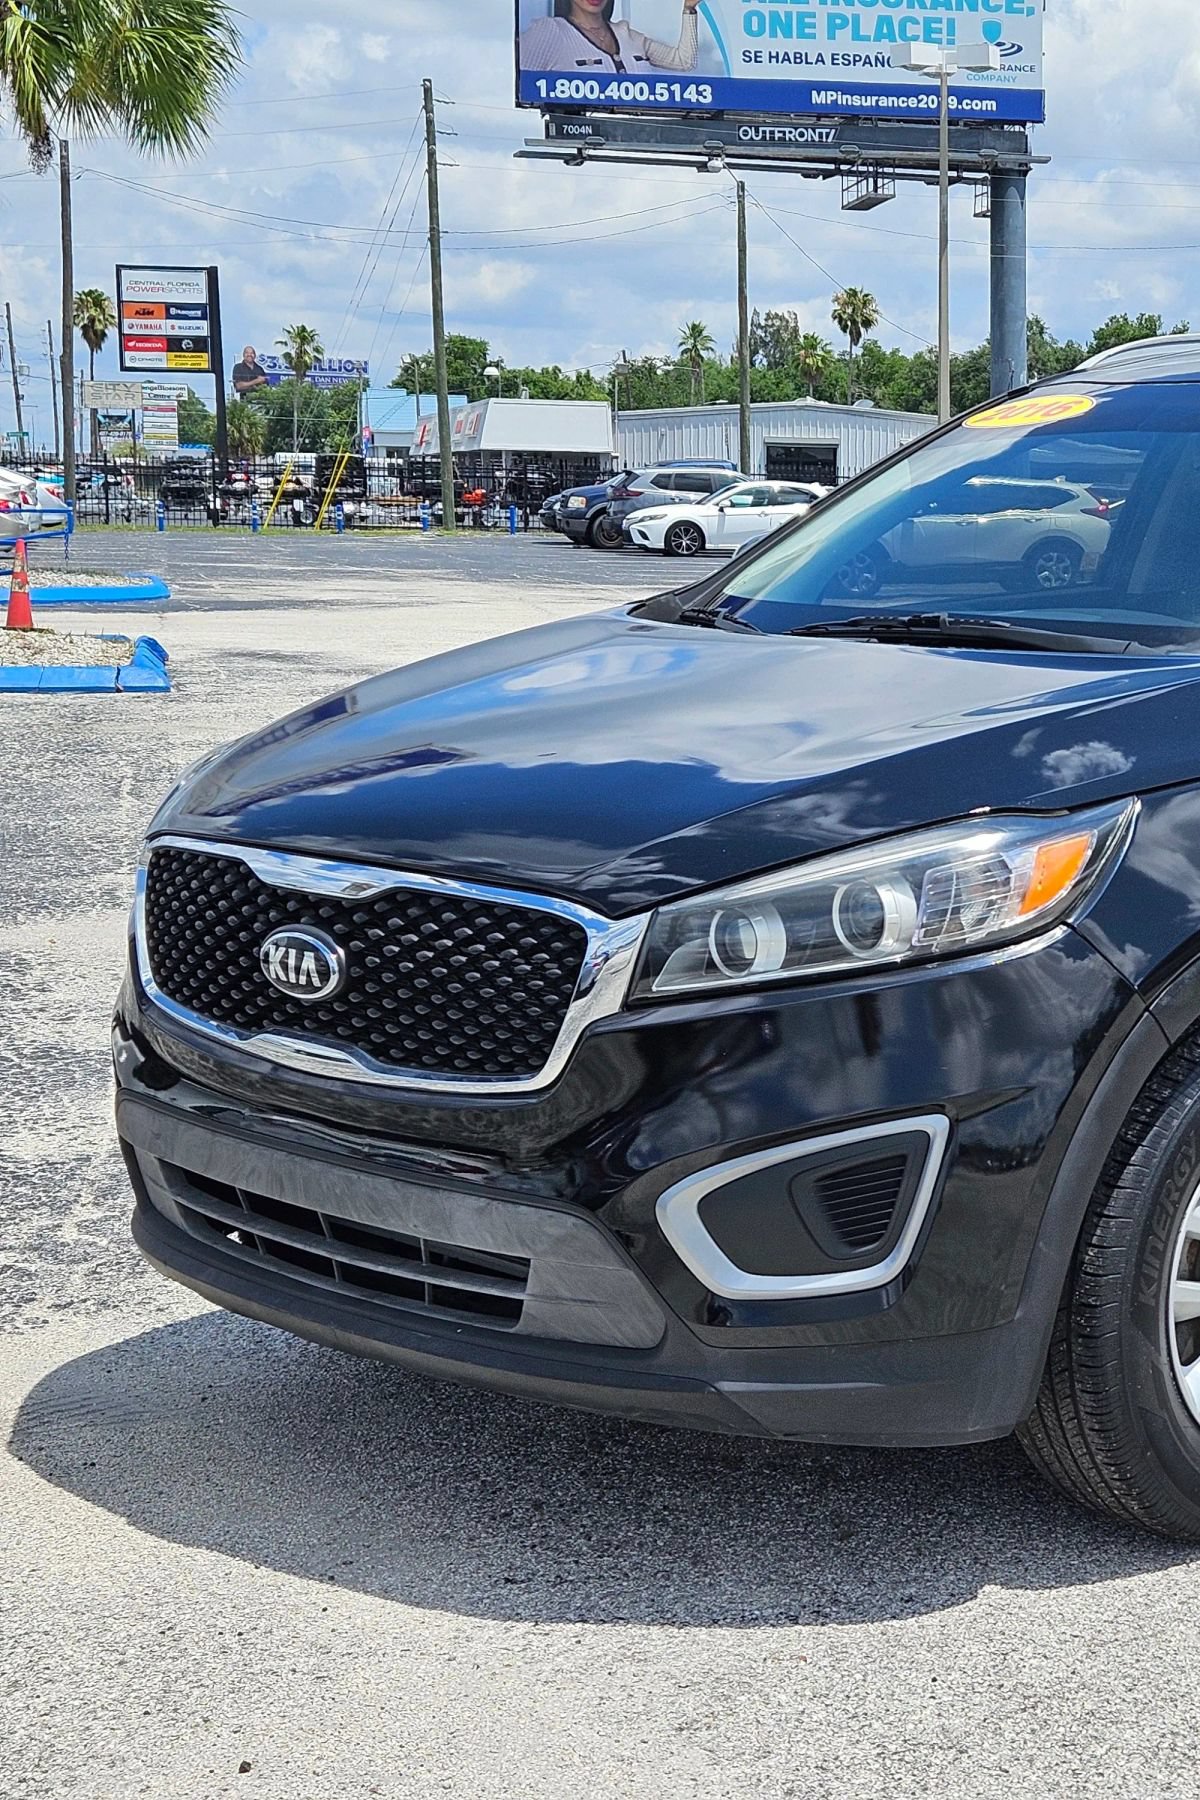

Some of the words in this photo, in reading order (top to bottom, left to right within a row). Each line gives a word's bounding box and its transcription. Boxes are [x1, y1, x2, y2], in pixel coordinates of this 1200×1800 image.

[743, 9, 817, 40] ONE
[827, 12, 956, 46] PLACE!
[742, 50, 763, 64] SE
[768, 51, 826, 66] HABLA
[966, 74, 1018, 83] COMPANY
[535, 78, 713, 104] 1.800.400.5143
[562, 124, 592, 135] 7004N
[126, 286, 204, 294] POWERSPORTS
[134, 307, 154, 316] KTM
[91, 383, 136, 392] CITY
[91, 393, 136, 401] STAR
[268, 944, 322, 987] KIA
